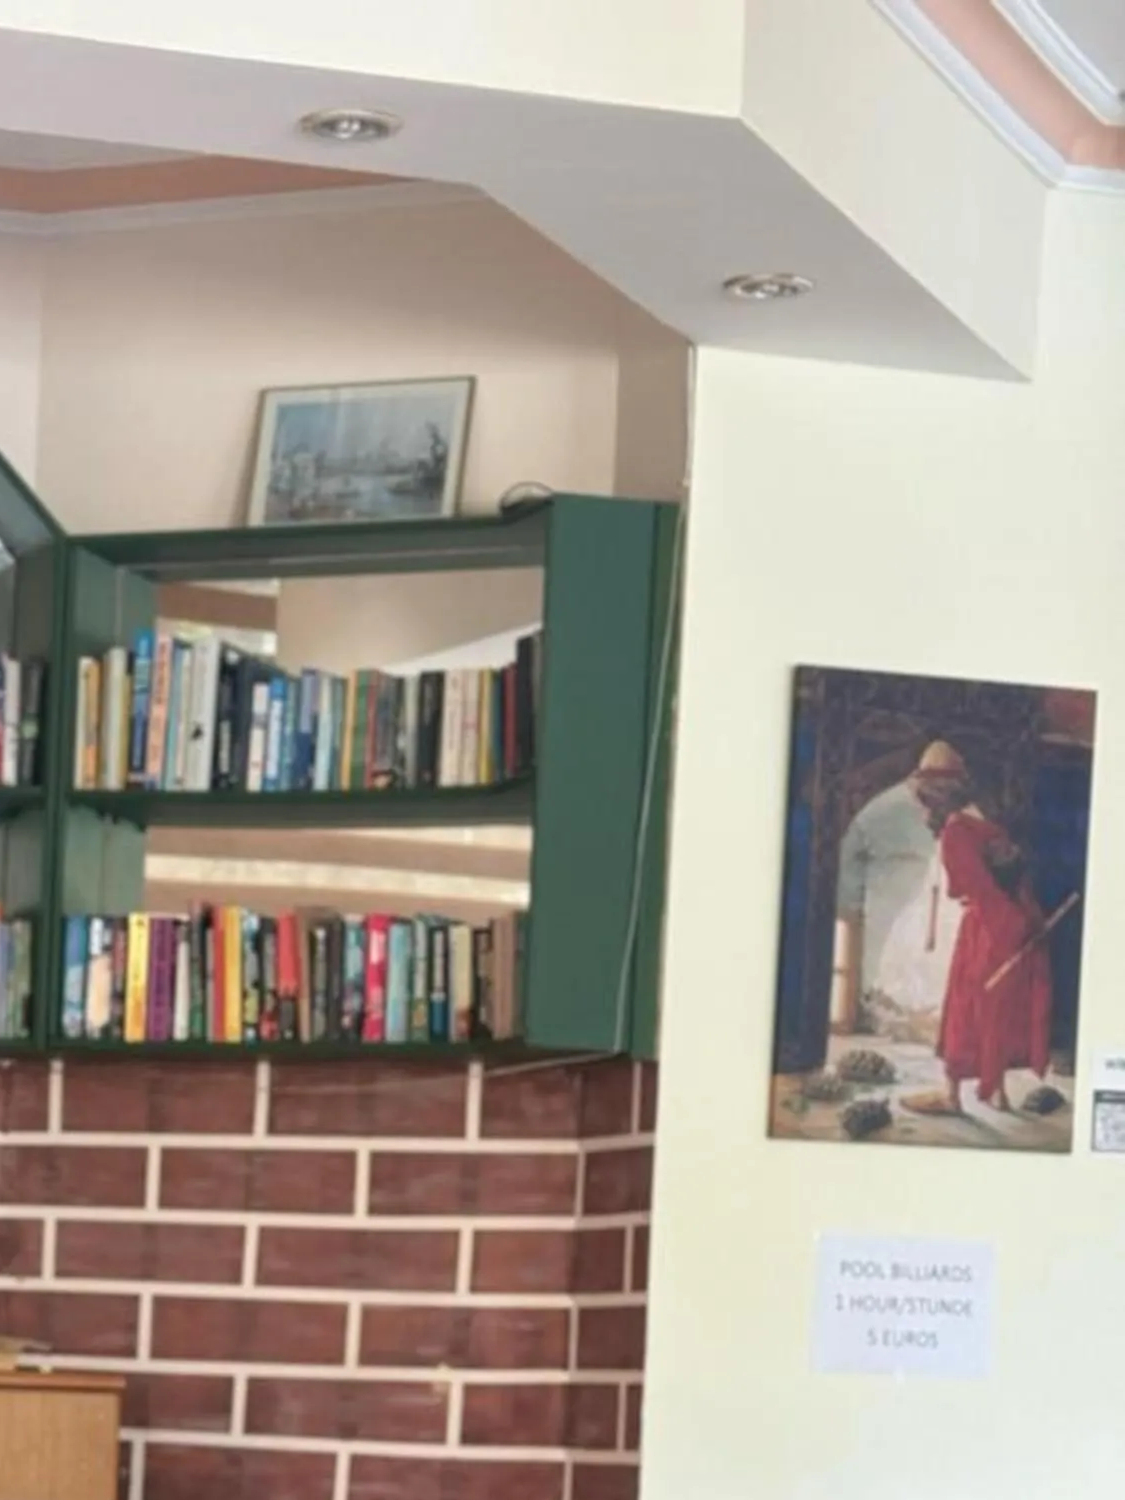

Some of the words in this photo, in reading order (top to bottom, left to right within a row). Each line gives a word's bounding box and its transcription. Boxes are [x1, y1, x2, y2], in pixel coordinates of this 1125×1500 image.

[839, 1260, 885, 1280] POOL
[890, 1262, 972, 1283] BILLIARDS
[835, 1292, 844, 1312] 1
[849, 1294, 973, 1317] HOUR/STUNDE
[881, 1329, 939, 1349] EUROS
